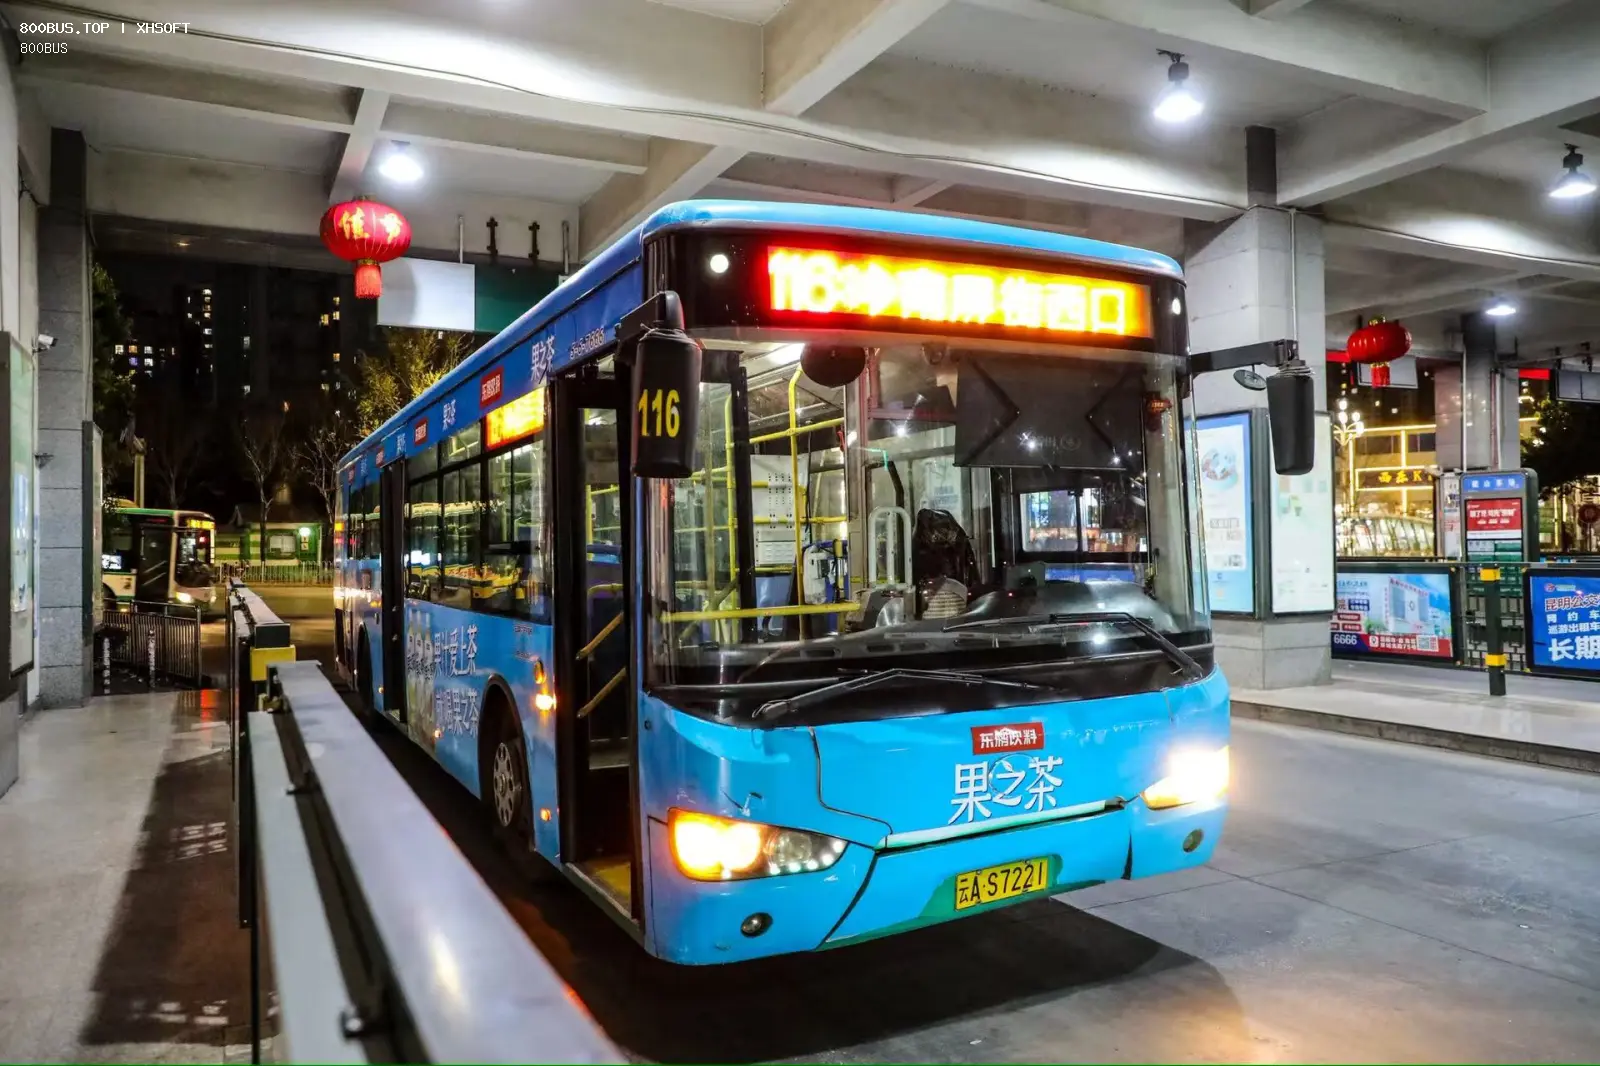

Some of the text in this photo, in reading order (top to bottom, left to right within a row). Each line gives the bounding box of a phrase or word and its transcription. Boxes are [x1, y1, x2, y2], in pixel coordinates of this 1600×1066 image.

[638, 389, 680, 438] 116
[1333, 634, 1358, 646] 6666
[1548, 635, 1600, 662] 长期
[979, 727, 1038, 749] 东鹏饮料
[948, 755, 1064, 825] 果之茶
